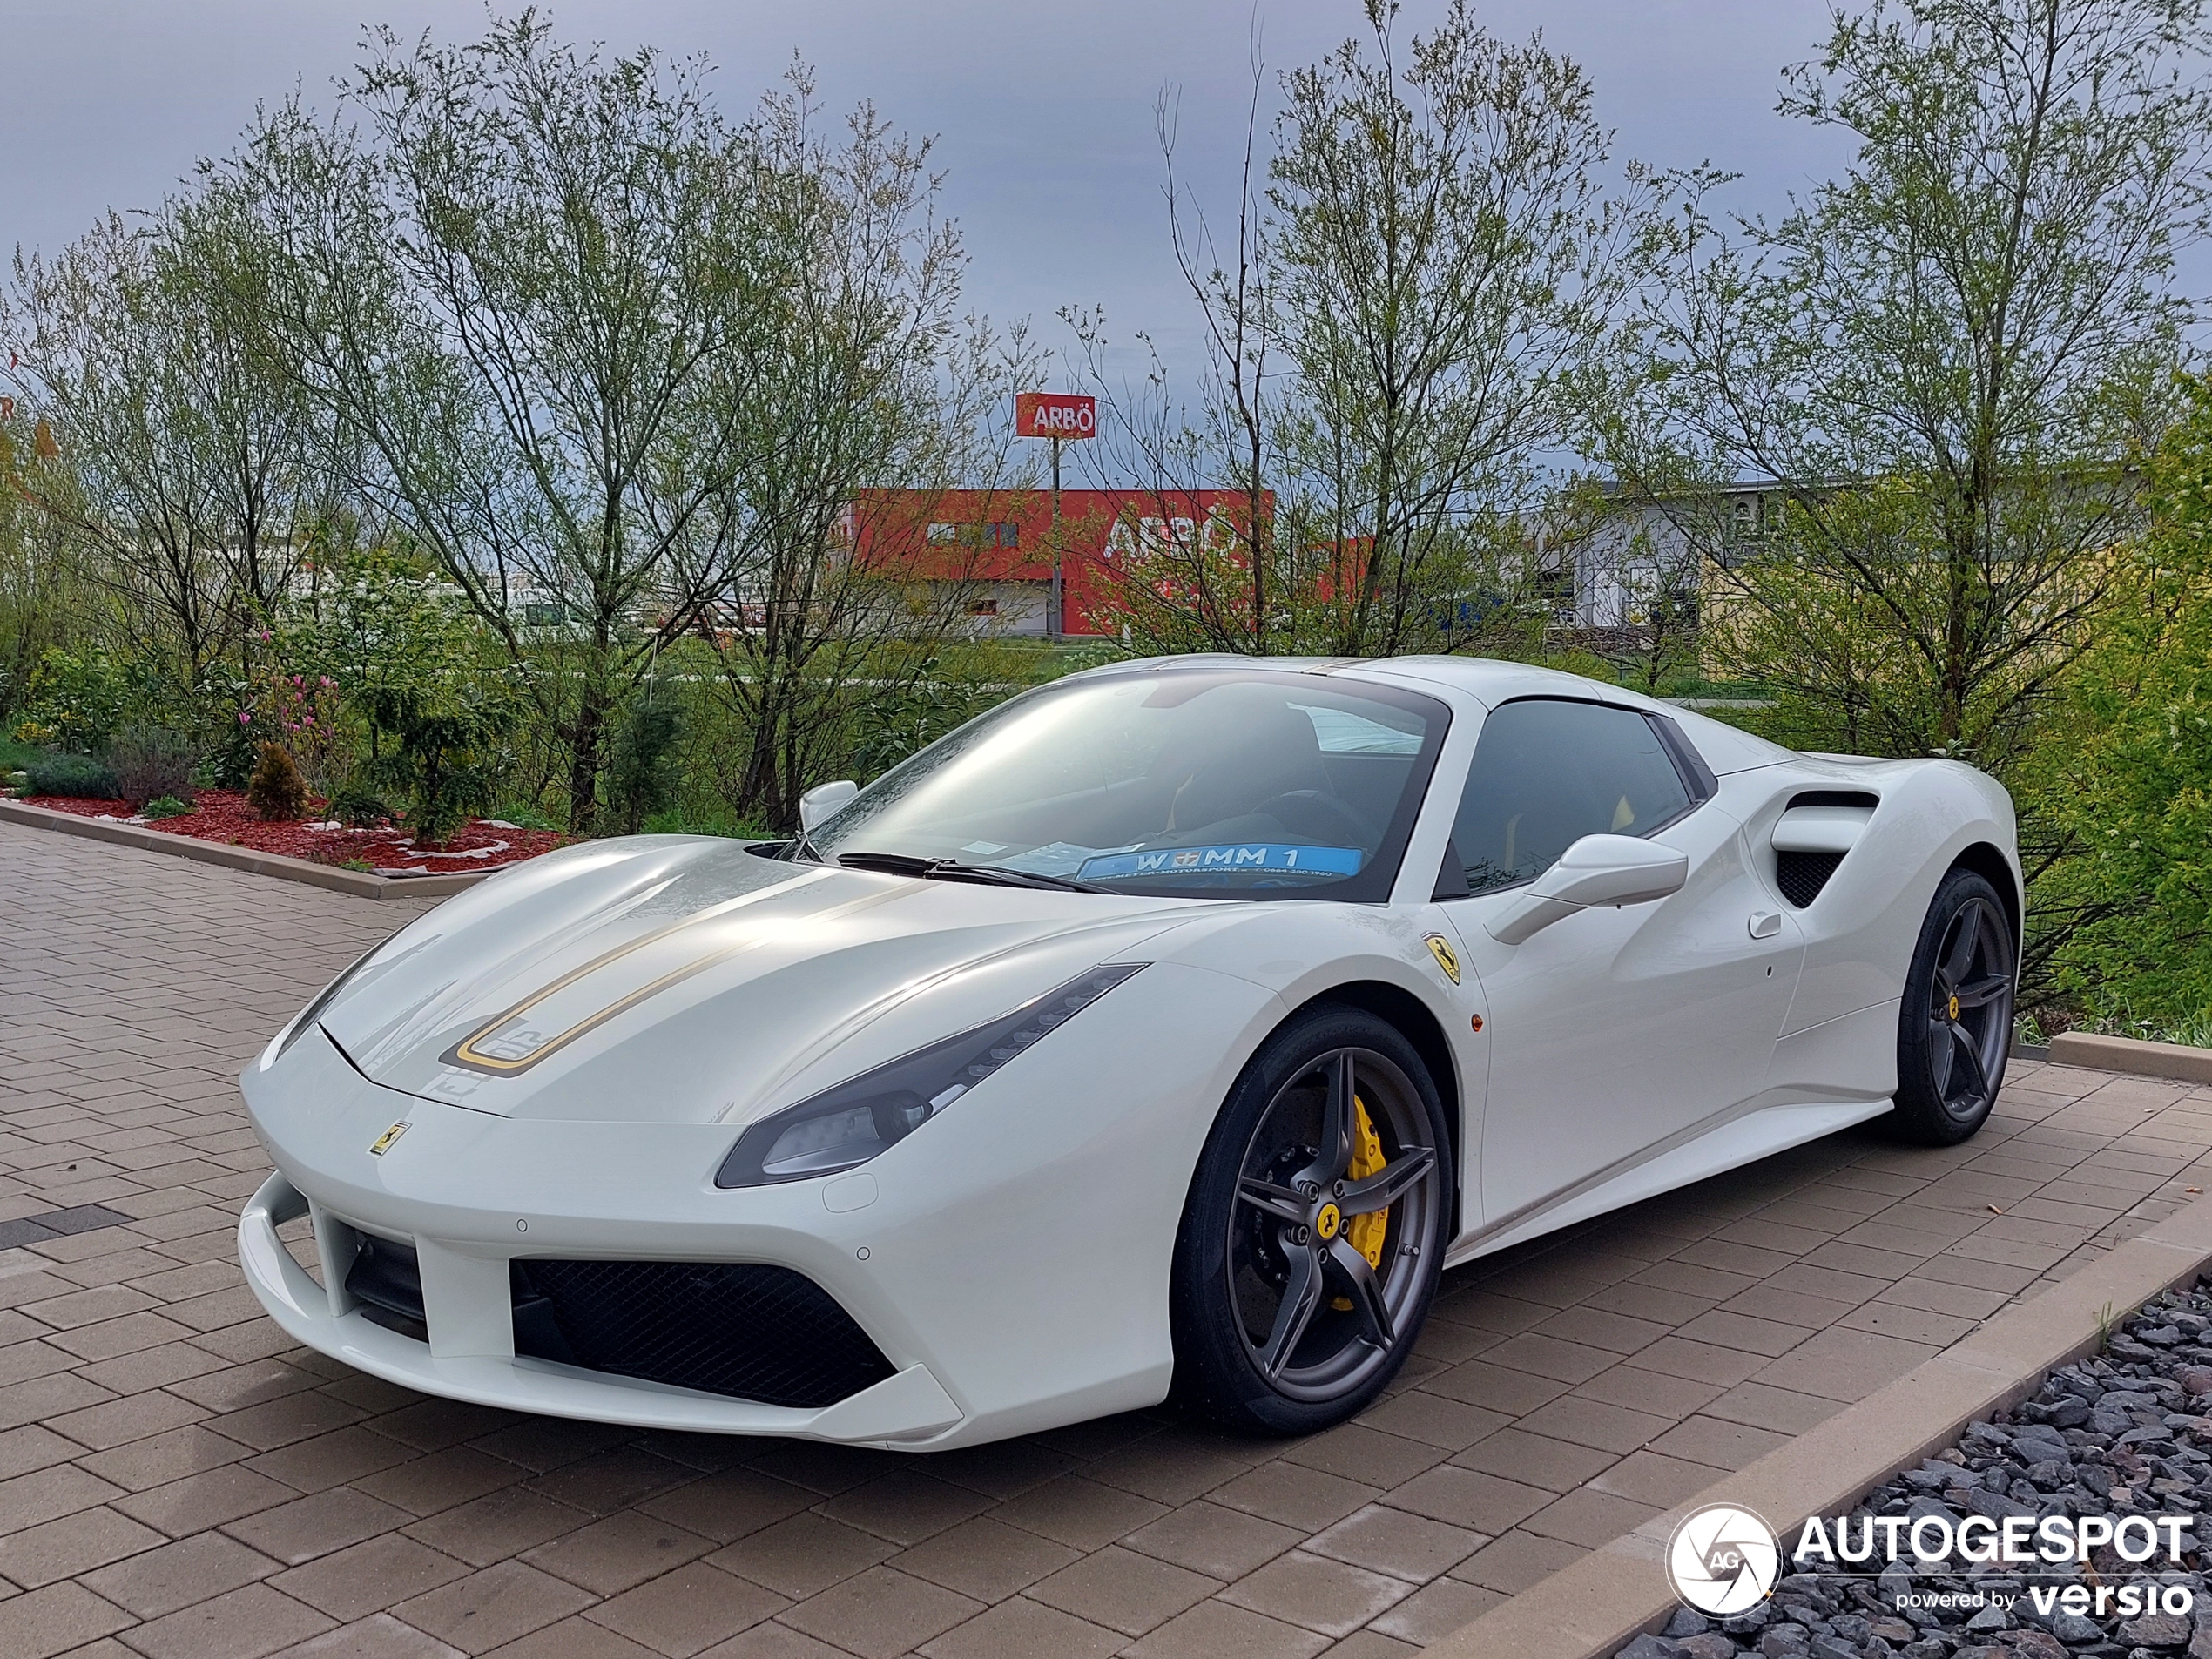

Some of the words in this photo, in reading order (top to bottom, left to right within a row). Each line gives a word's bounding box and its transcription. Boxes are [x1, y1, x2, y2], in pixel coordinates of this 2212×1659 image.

[1033, 402, 1094, 432] ARBÖ
[1137, 853, 1169, 871] W
[1204, 848, 1268, 866] MM
[1282, 849, 1299, 867] 1
